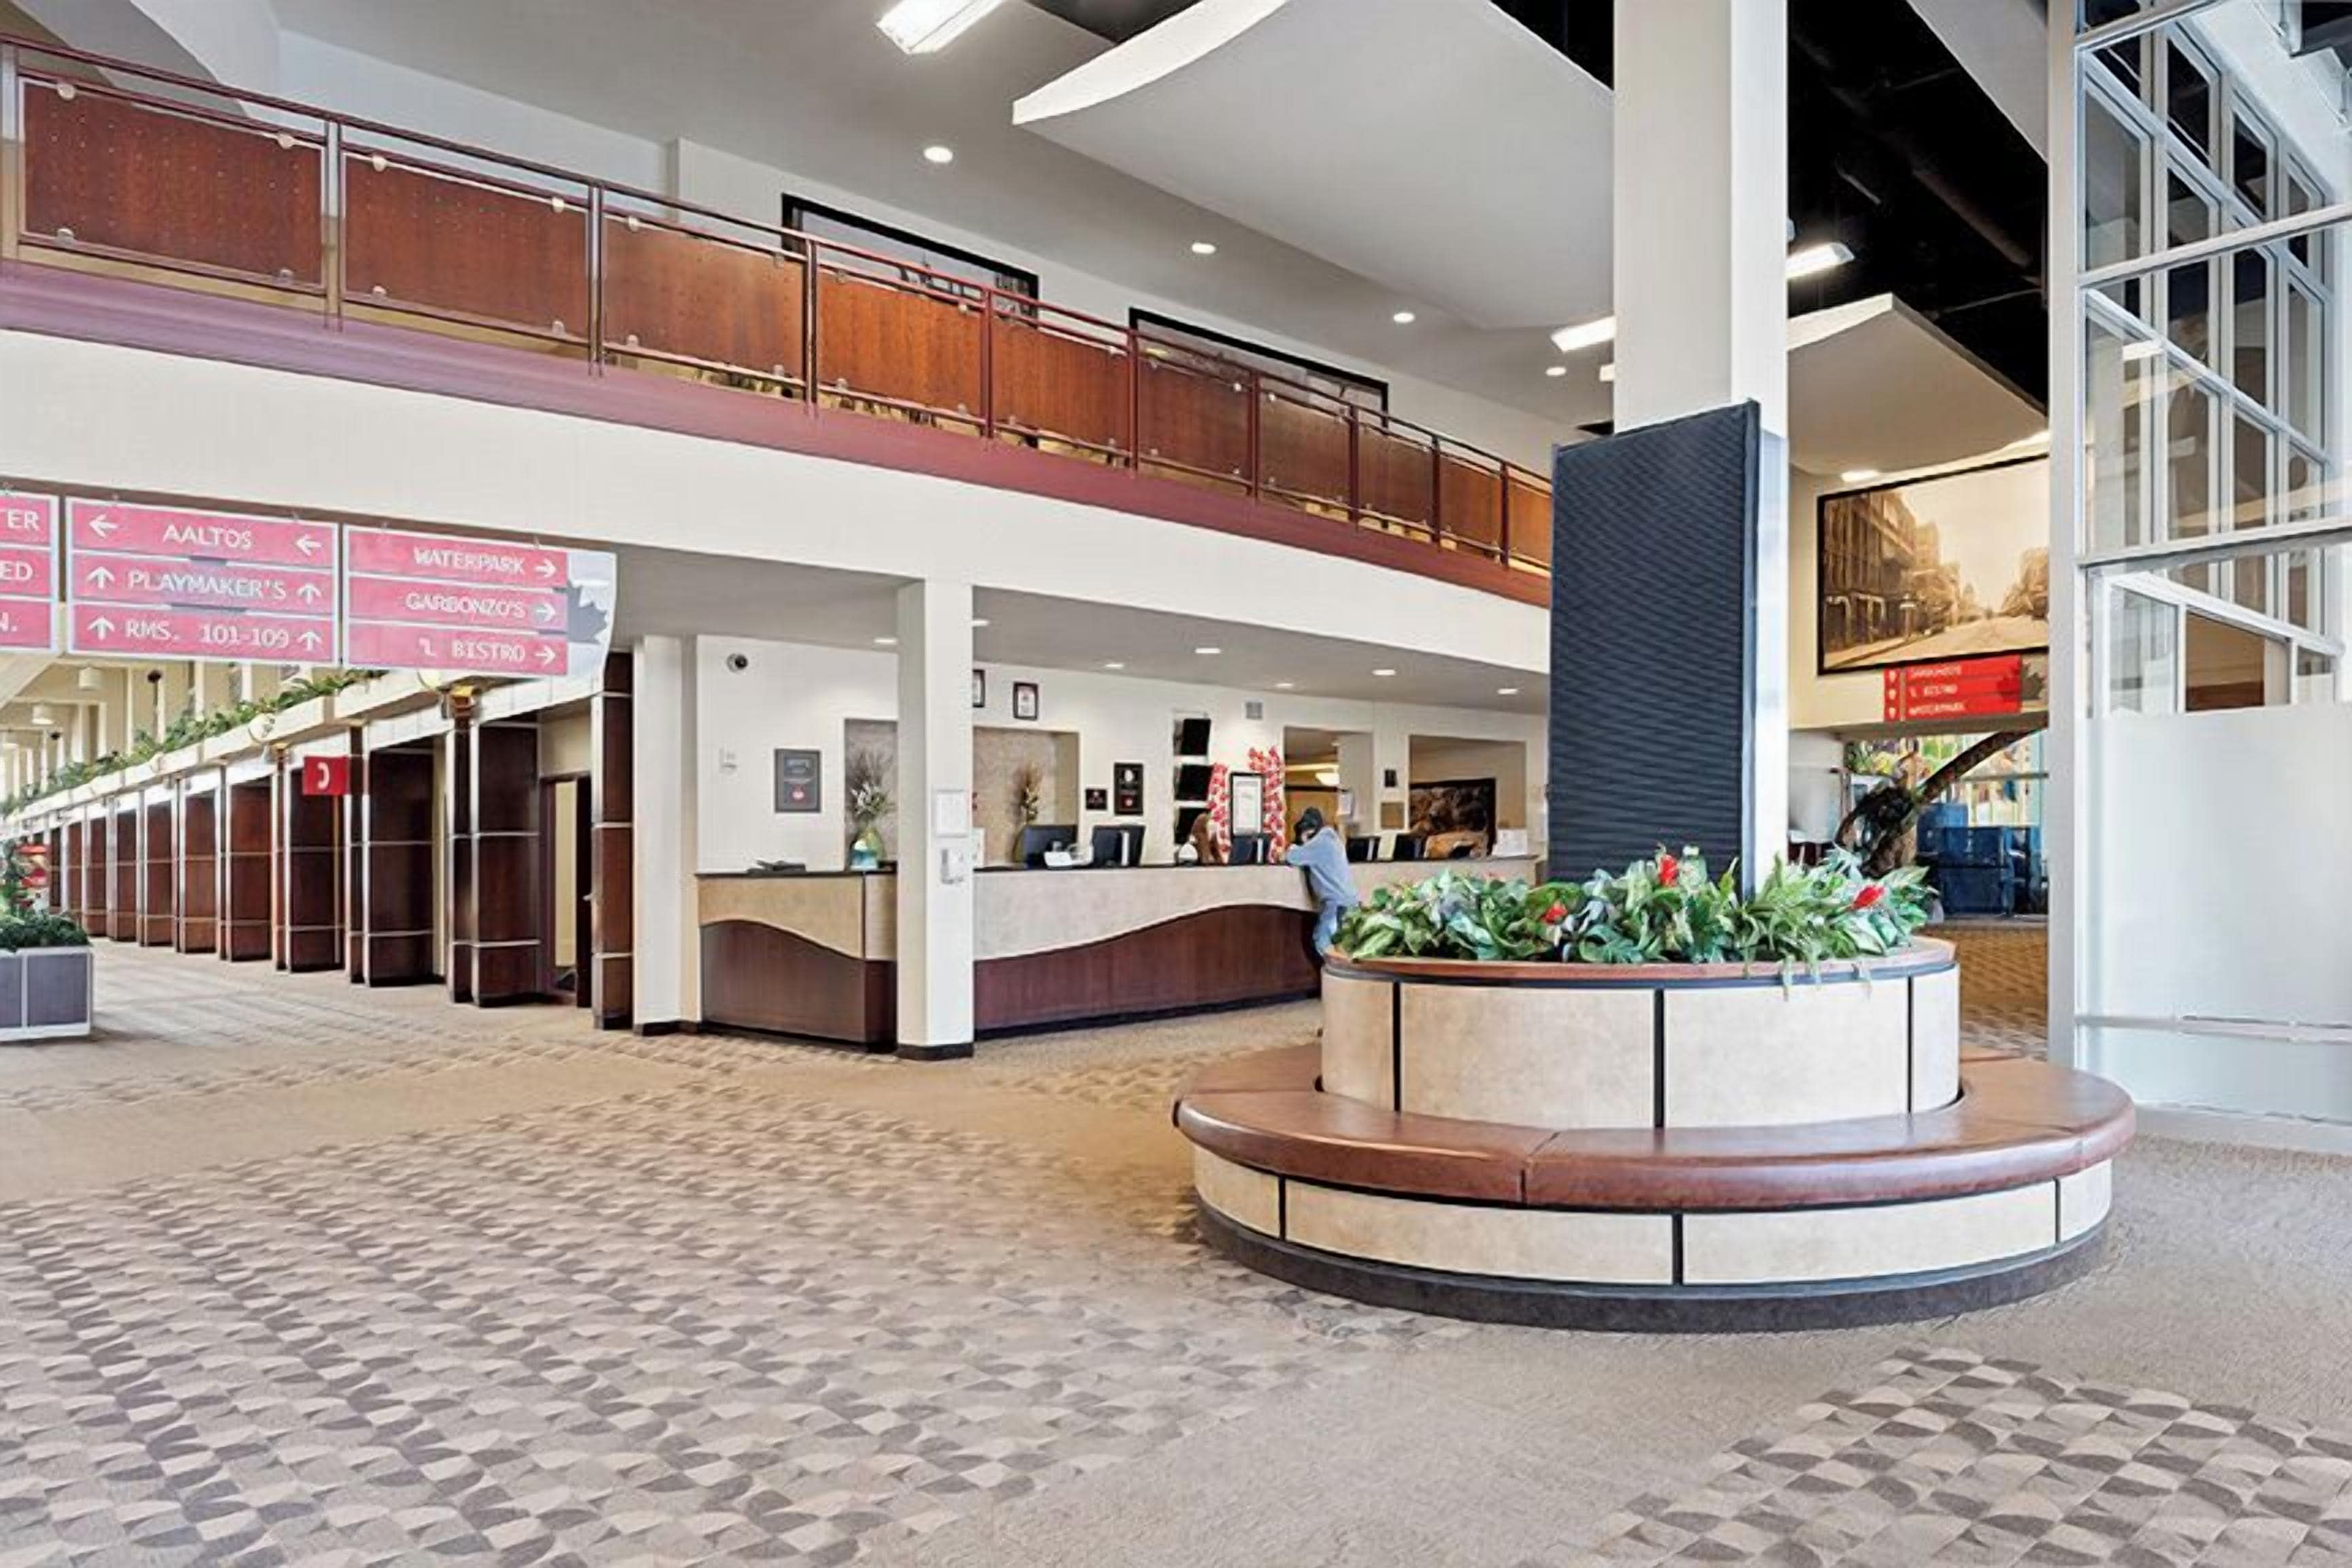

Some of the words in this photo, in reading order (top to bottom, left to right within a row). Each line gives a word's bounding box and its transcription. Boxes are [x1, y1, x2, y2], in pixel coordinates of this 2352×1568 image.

[162, 523, 252, 550] AALTOS
[413, 547, 525, 574] WATERPARK
[127, 569, 287, 601] PLAYMAKER'S
[125, 619, 181, 642] RMS.
[201, 623, 291, 649] 101-109
[451, 638, 526, 663] BISTRO
